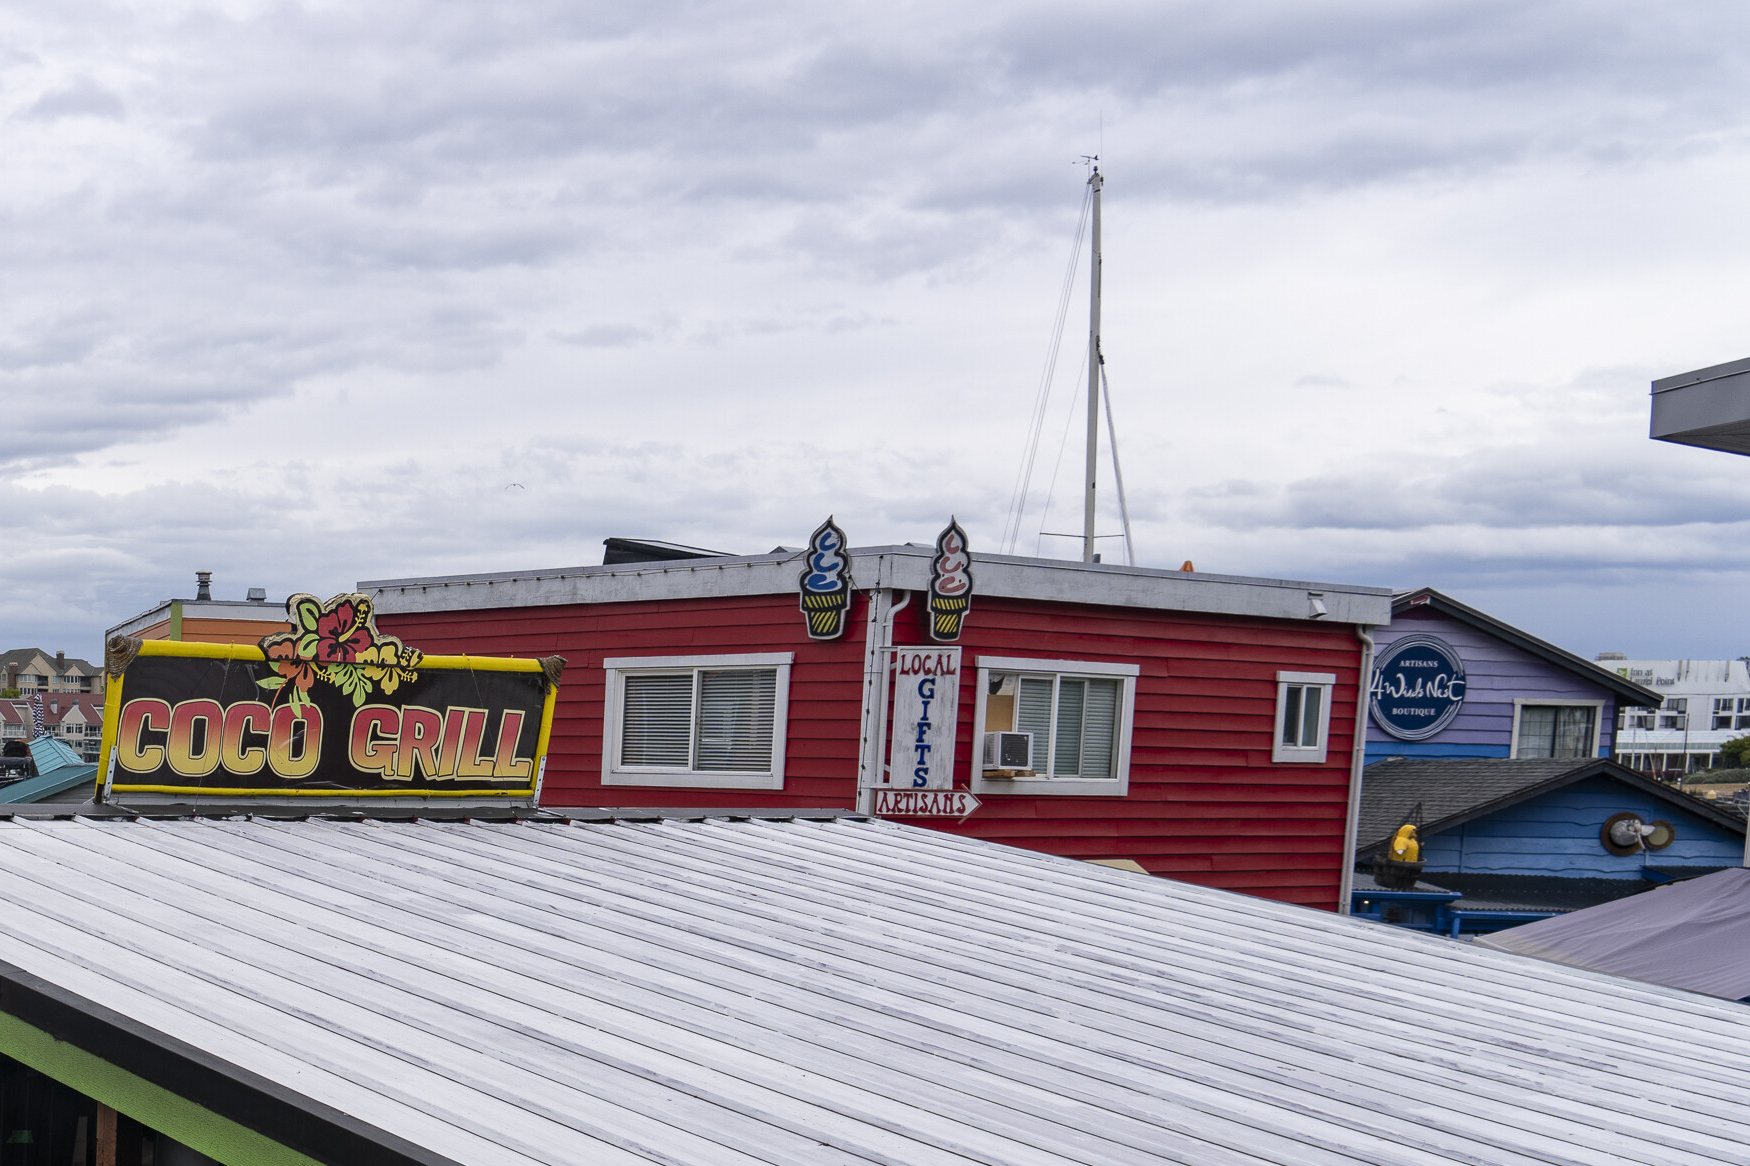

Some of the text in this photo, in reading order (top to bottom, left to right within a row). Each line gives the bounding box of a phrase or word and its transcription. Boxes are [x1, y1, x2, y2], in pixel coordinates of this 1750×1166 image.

[899, 653, 957, 676] LOCAL
[1399, 660, 1438, 668] ARTISANS
[1630, 667, 1643, 676] Inn
[1370, 668, 1385, 700] 4
[1656, 677, 1675, 685] Point
[1392, 708, 1436, 717] BOUTIQUE
[117, 697, 533, 782] COCO GRILL
[913, 677, 936, 788] GIFTS
[878, 791, 966, 815] ARTISANS
